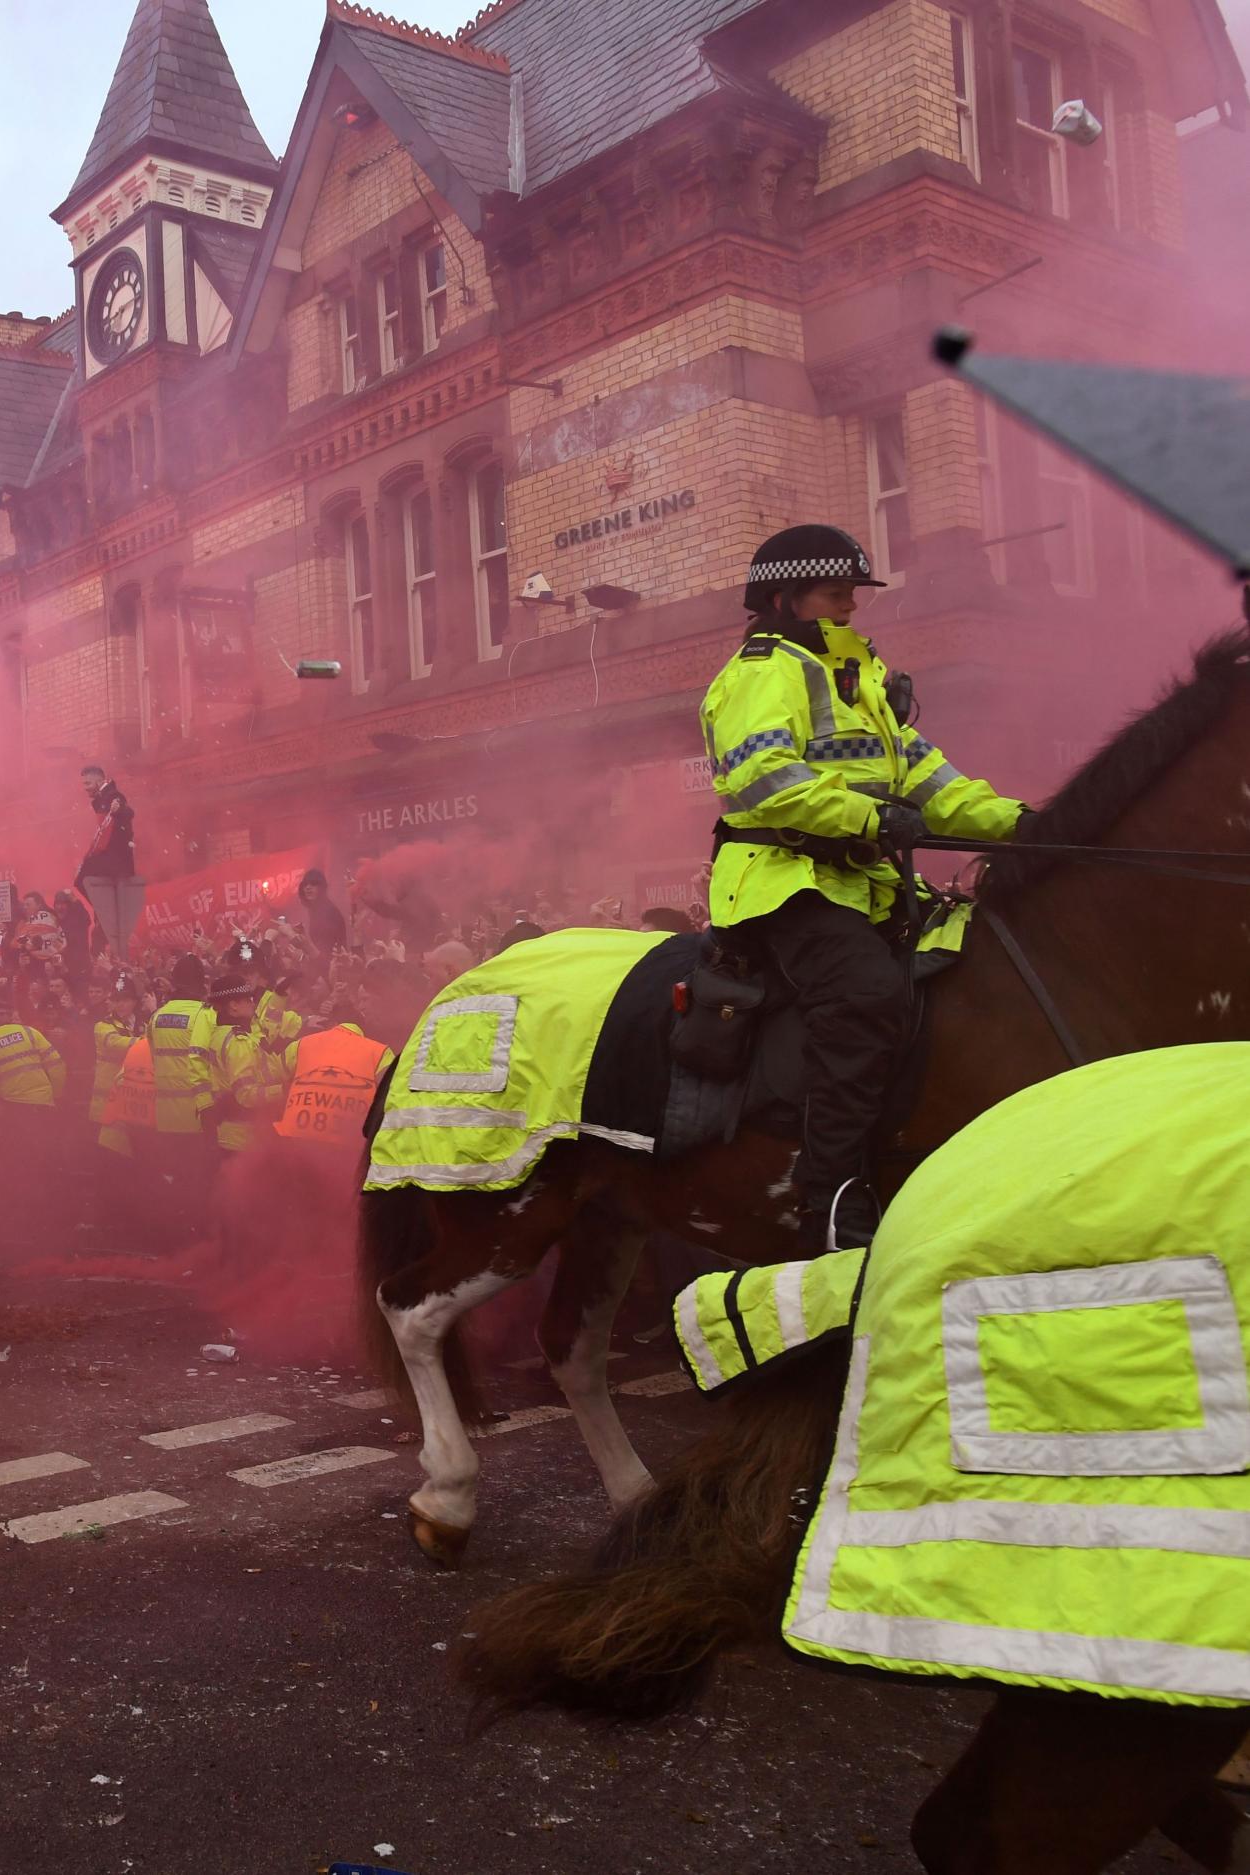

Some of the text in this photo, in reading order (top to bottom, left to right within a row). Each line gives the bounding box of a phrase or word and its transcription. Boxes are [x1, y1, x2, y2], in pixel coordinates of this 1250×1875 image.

[555, 510, 632, 549] GREENE
[639, 490, 696, 523] KING
[684, 759, 711, 773] ARK
[684, 775, 711, 790] LAN
[358, 794, 479, 833] THE ARKLES
[188, 888, 214, 914] OF
[646, 884, 687, 905] WATCH
[157, 1015, 188, 1028] POLICE
[287, 1091, 367, 1115] STEWARD
